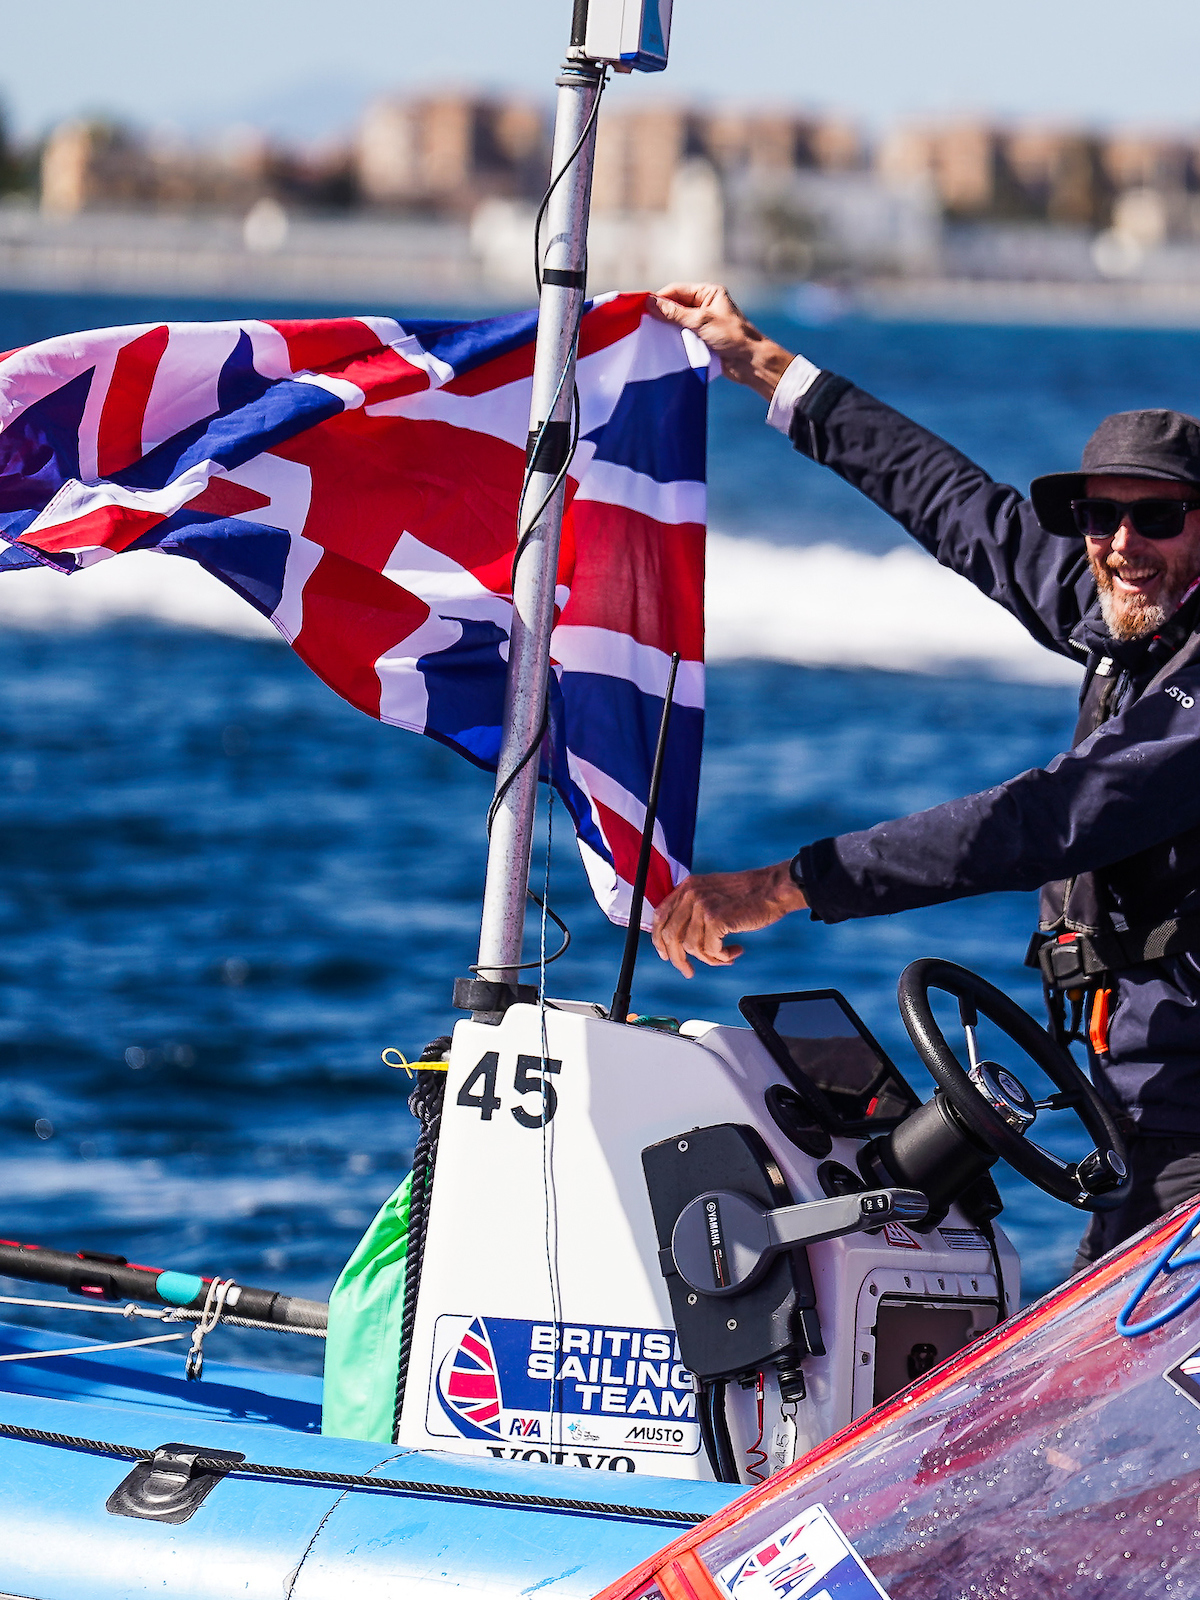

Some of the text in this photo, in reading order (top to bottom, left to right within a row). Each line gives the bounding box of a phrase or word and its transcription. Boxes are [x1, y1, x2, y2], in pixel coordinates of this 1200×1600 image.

[456, 1051, 562, 1129] 45
[708, 1211, 721, 1247] YAMAHA
[530, 1325, 682, 1361] BRITIS
[527, 1352, 694, 1390] SAILING
[575, 1384, 697, 1418] TEAM
[509, 1418, 541, 1438] RYA
[624, 1426, 684, 1443] MUSTO
